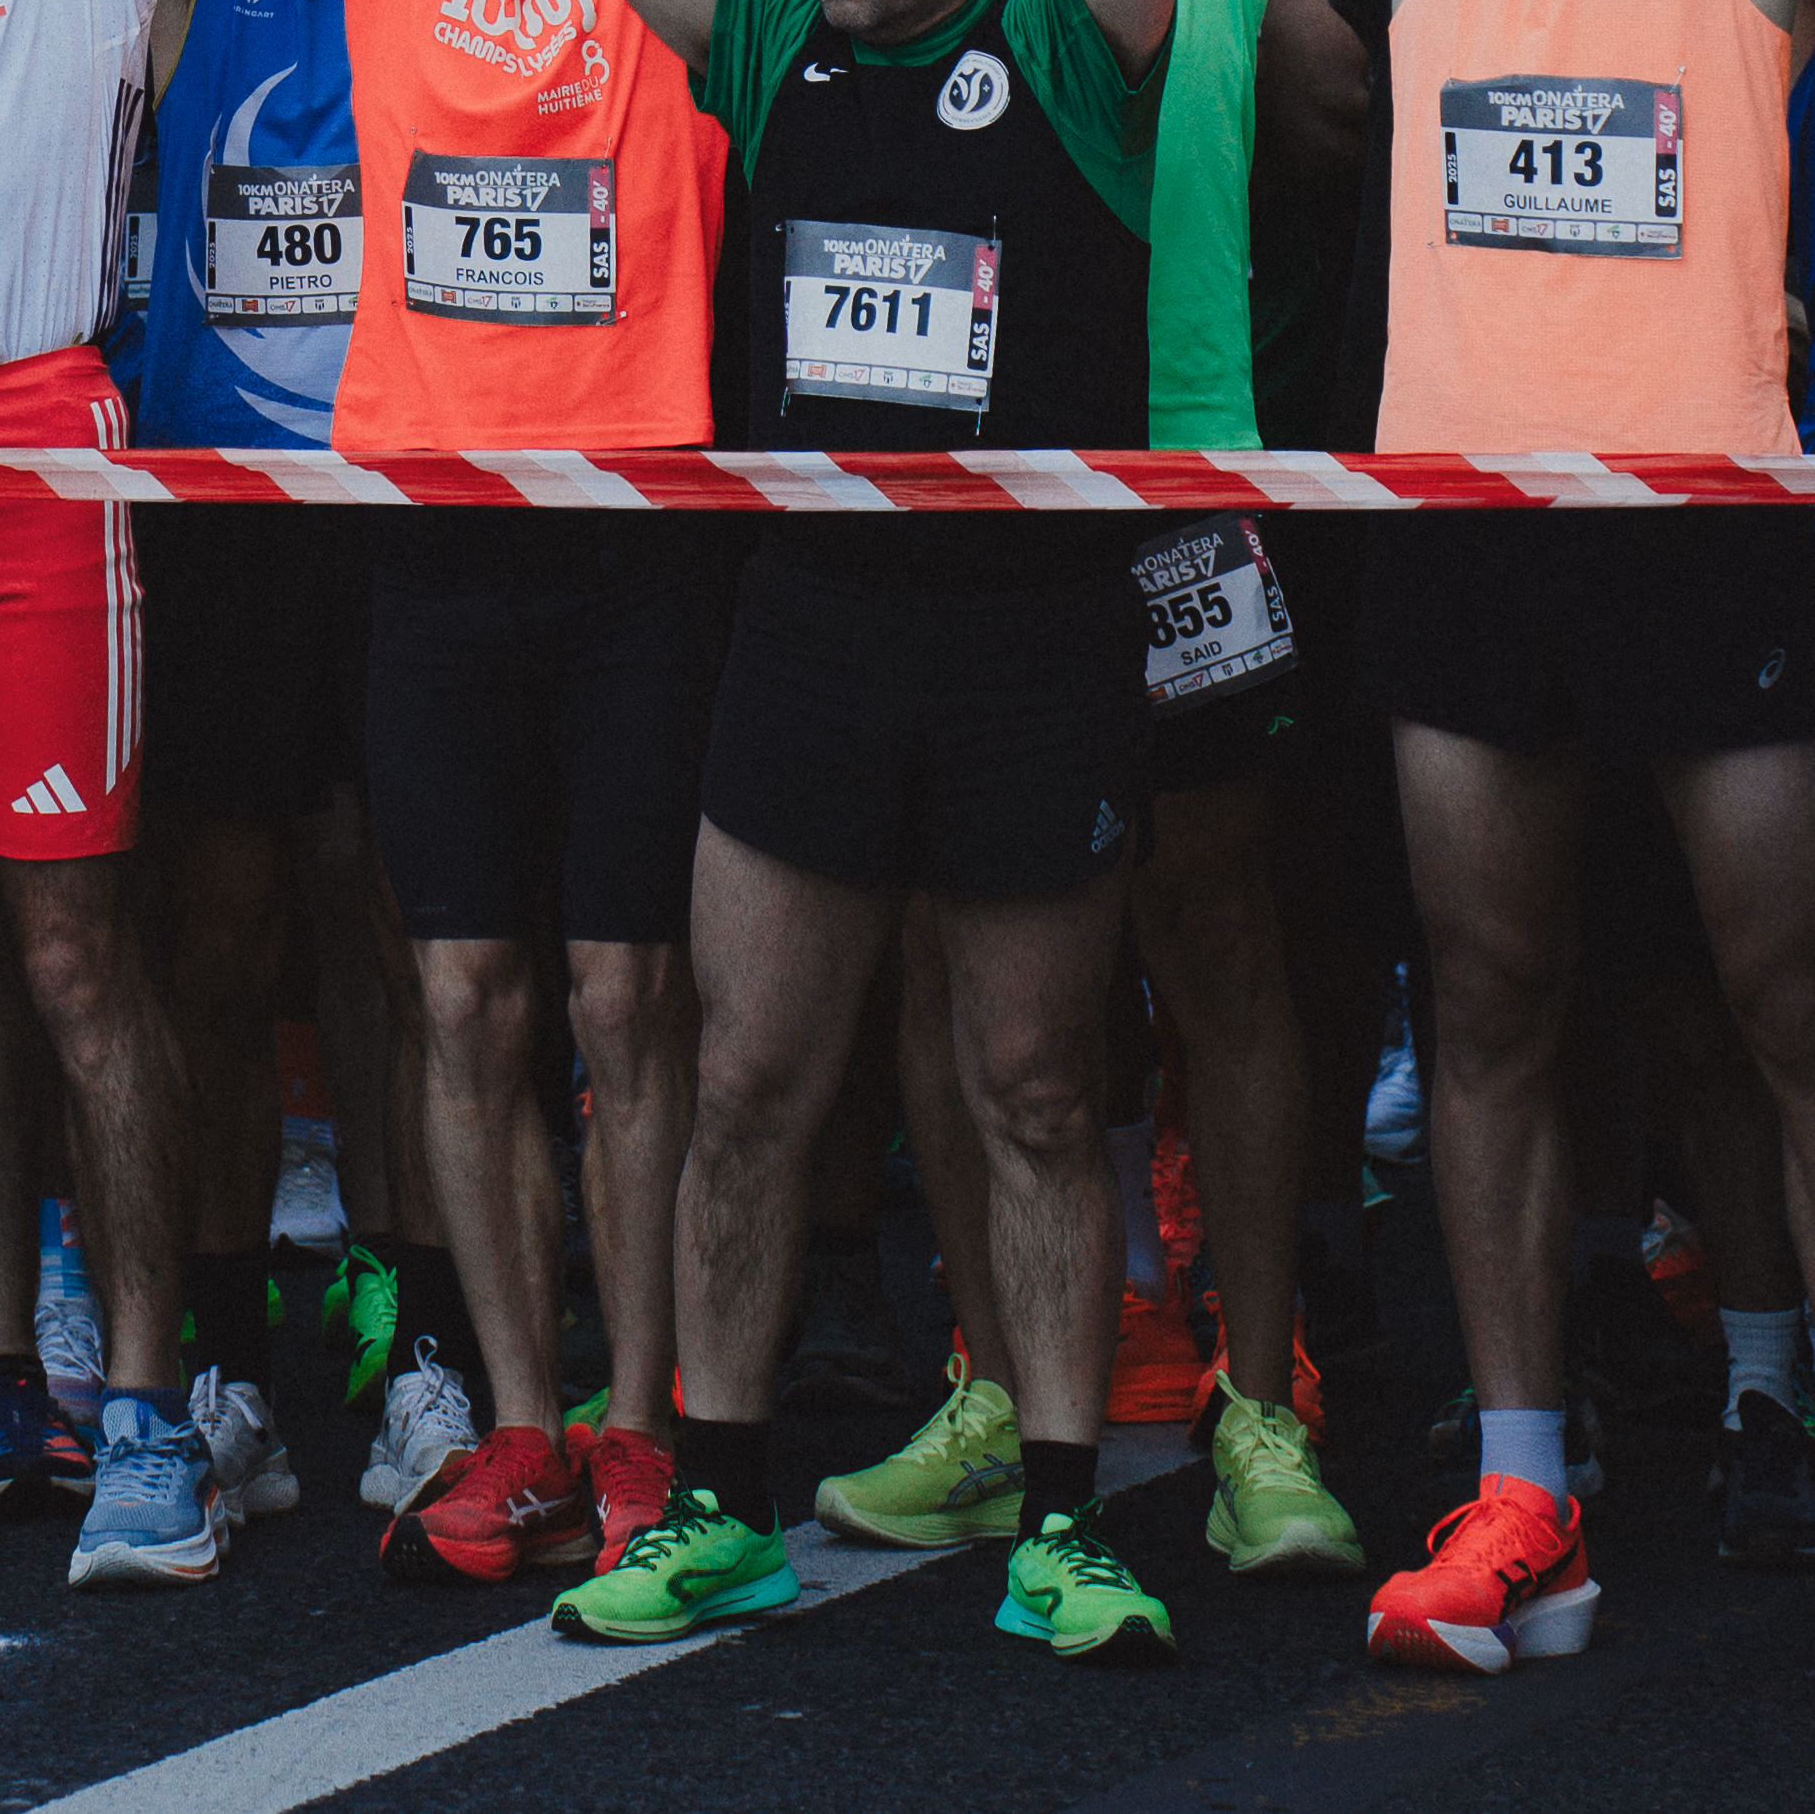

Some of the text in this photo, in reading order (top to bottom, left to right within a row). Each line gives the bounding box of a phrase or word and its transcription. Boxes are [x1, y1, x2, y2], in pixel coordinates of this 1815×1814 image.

[1448, 154, 1457, 183] 2025
[1508, 139, 1603, 187] 413
[1504, 194, 1612, 213] GUILLAUME
[1658, 168, 1676, 208] SAS
[256, 223, 341, 266] 480
[455, 216, 542, 261] 765
[456, 268, 544, 285] FRANCOIS
[593, 241, 609, 278] SAS
[270, 274, 332, 290] PIETRO
[824, 285, 932, 337] 7611
[971, 322, 989, 361] SAS
[1267, 585, 1286, 621] SAS
[1181, 640, 1222, 665] SAID
